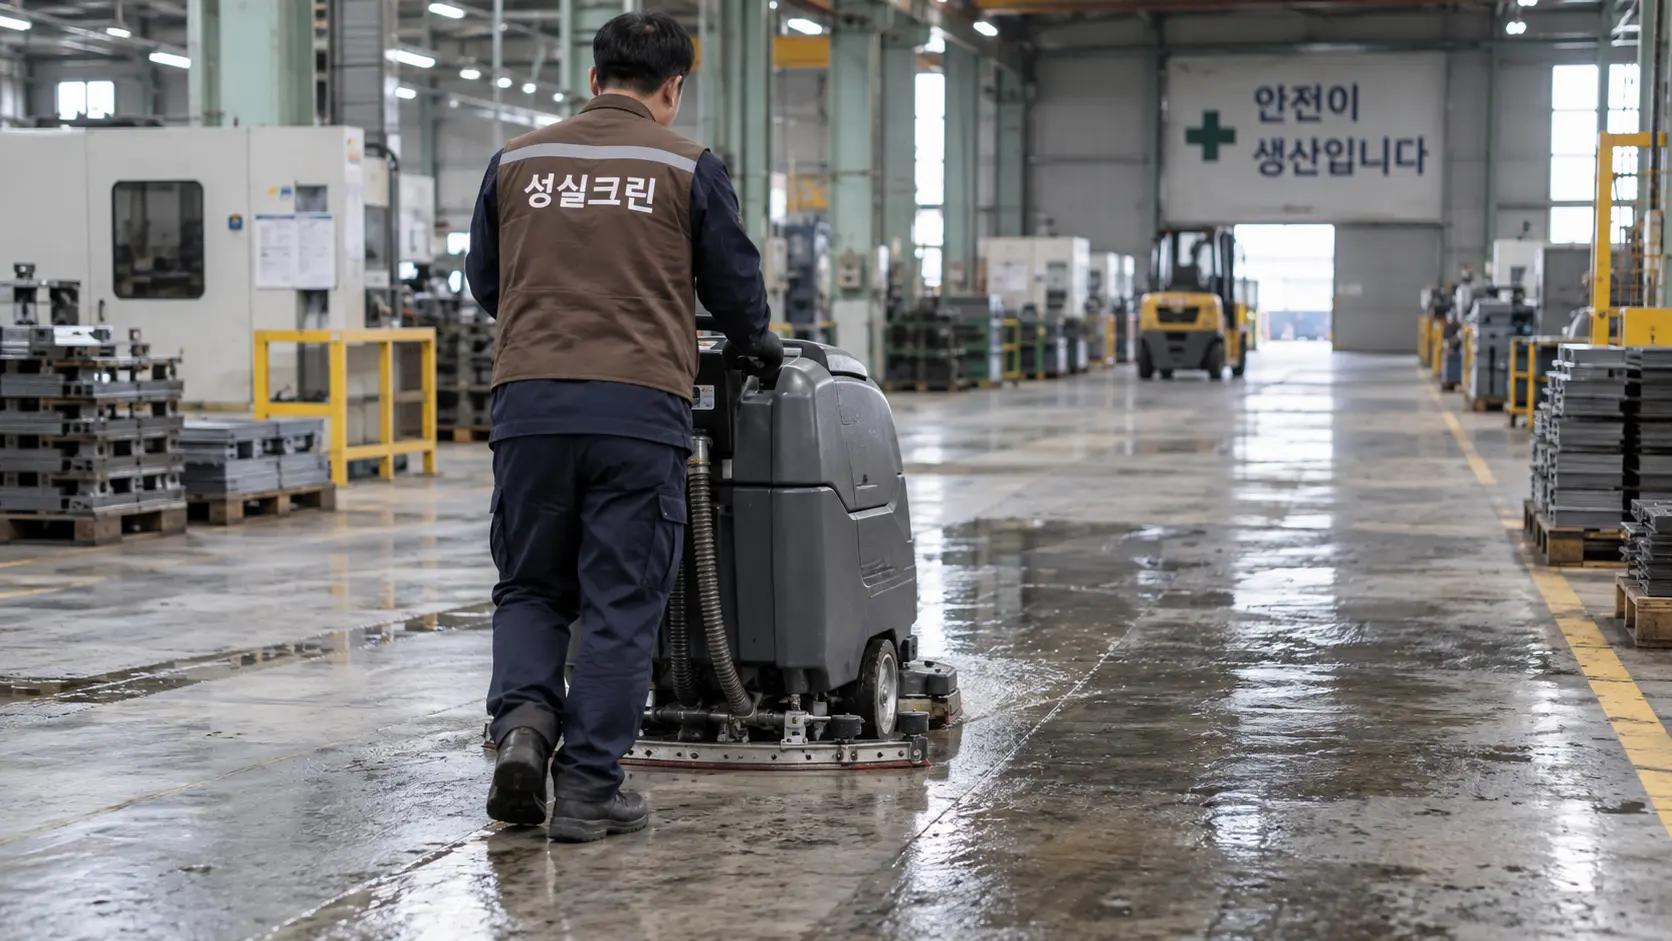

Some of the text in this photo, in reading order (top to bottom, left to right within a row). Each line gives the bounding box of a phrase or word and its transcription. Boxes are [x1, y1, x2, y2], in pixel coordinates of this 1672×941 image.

[1254, 83, 1358, 124] 안전이
[1253, 135, 1429, 177] 생산입니다
[524, 173, 656, 213] 성실크린
